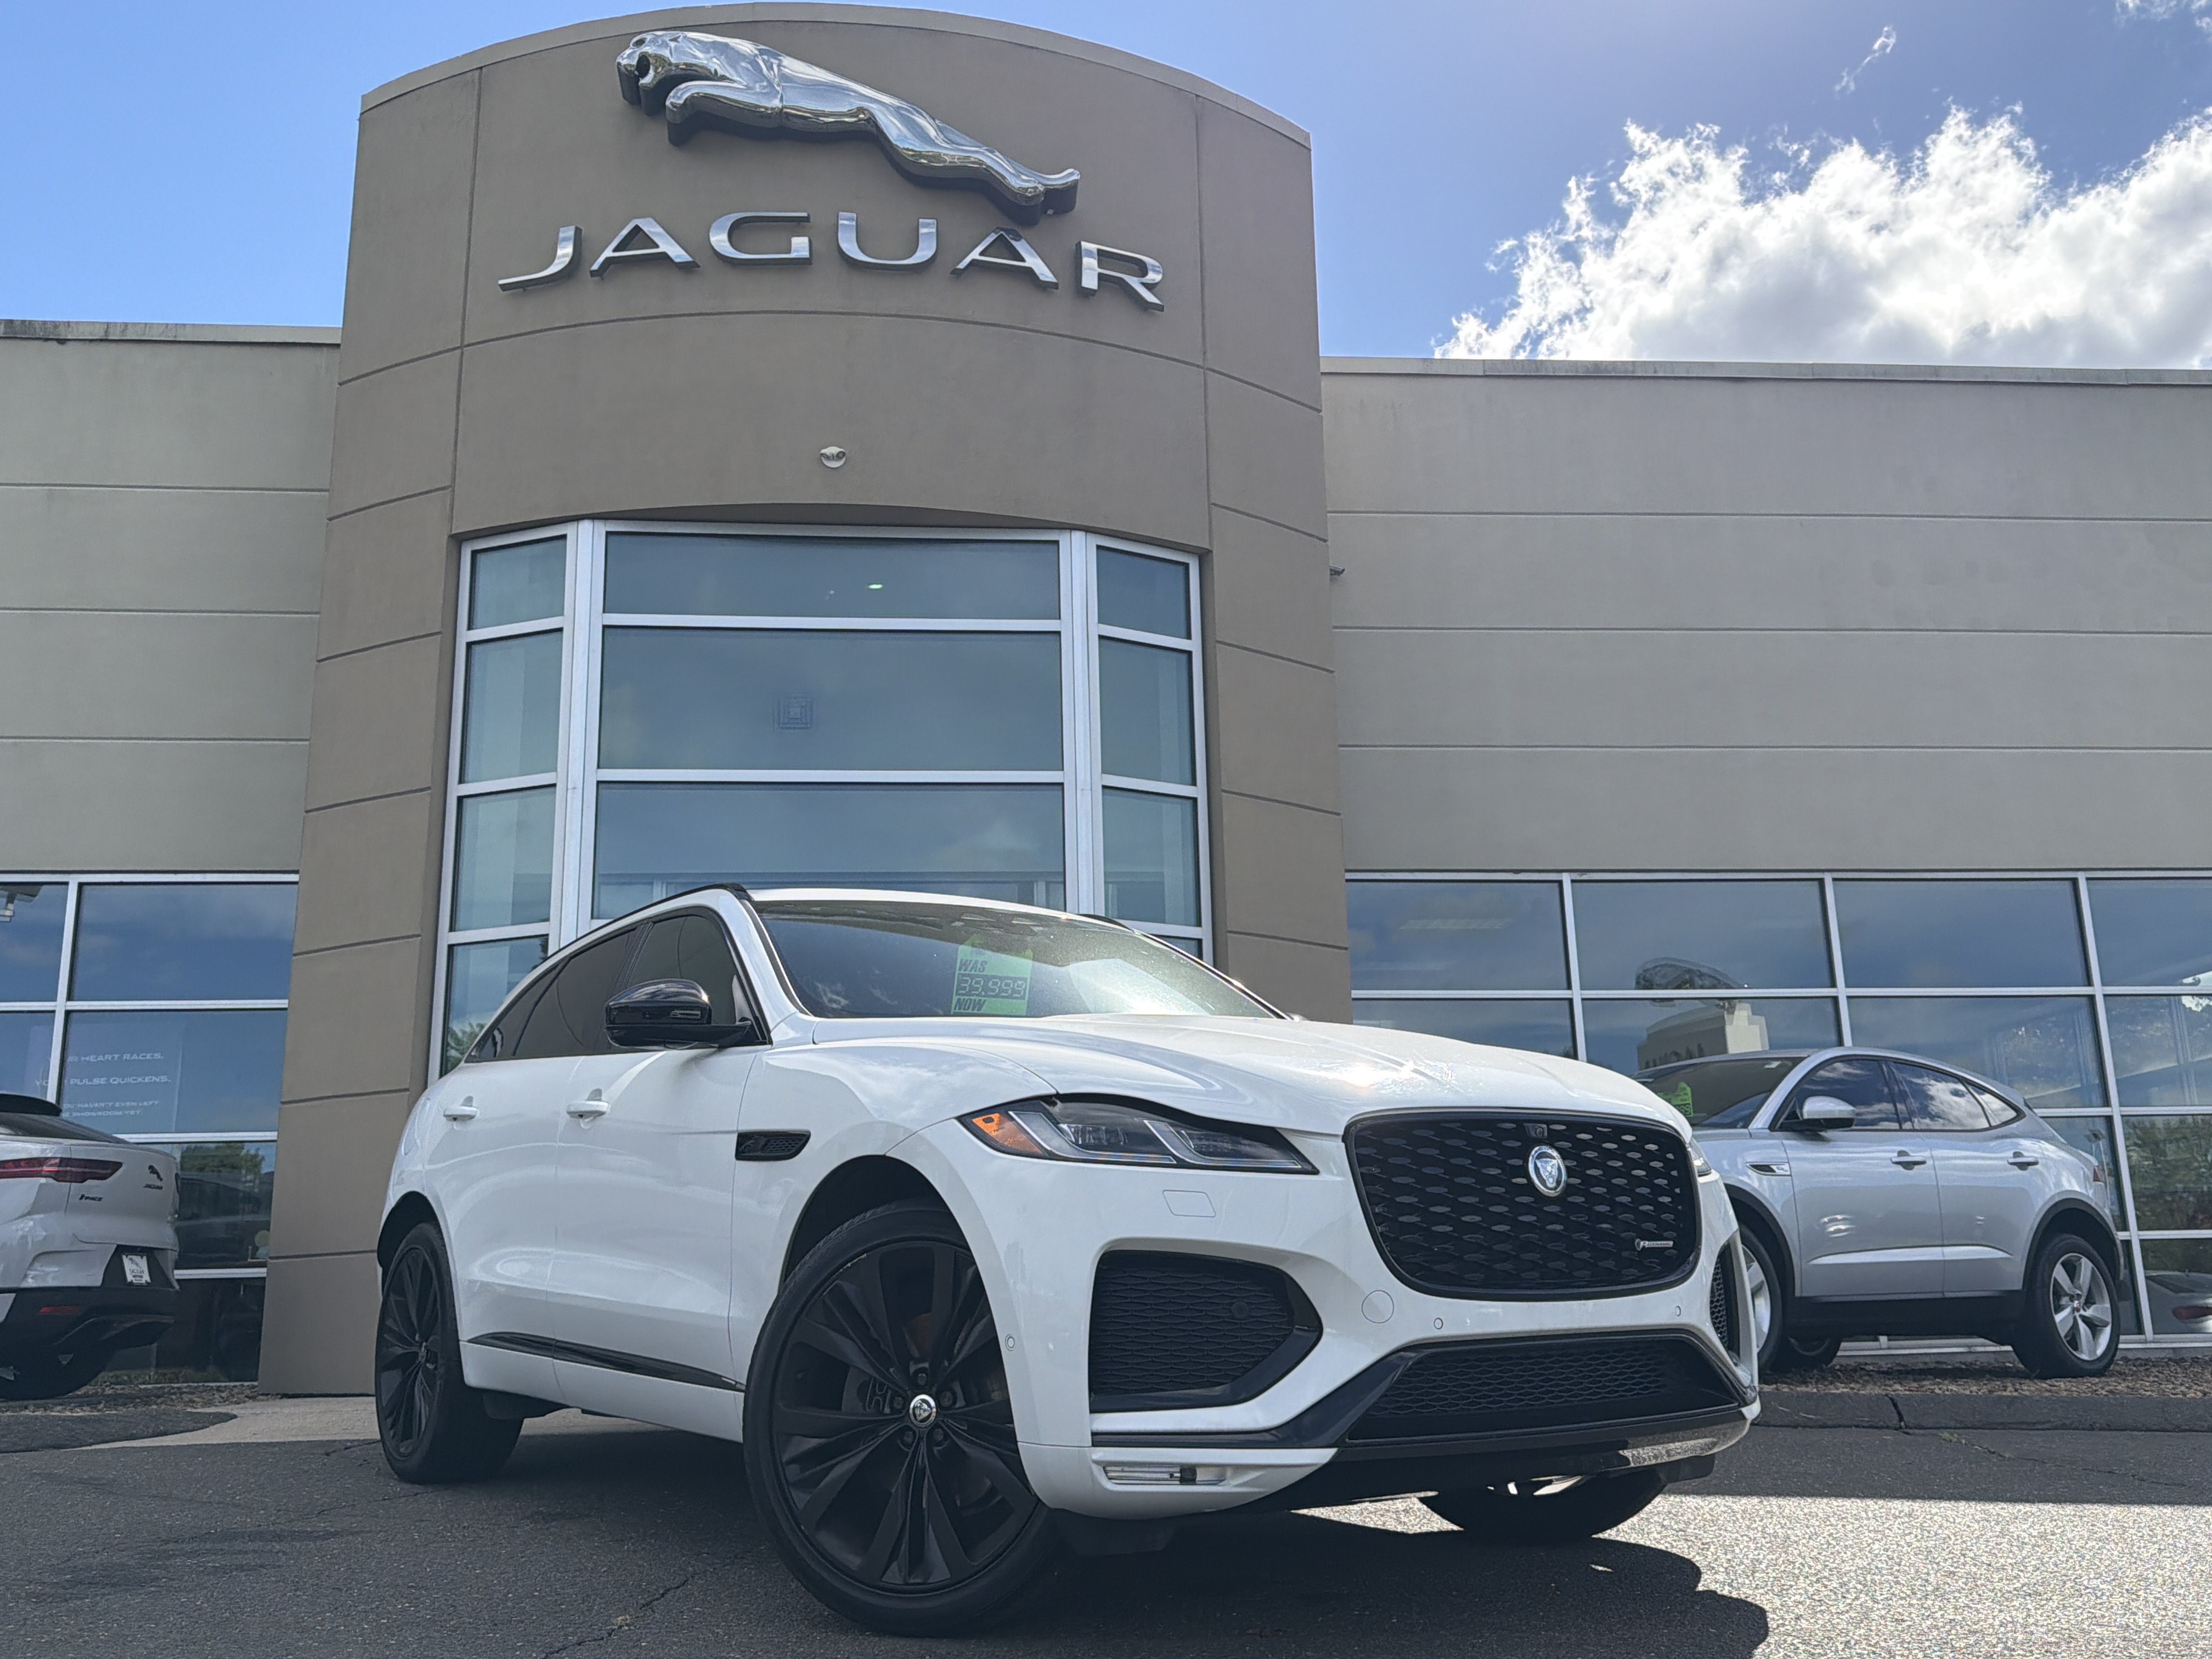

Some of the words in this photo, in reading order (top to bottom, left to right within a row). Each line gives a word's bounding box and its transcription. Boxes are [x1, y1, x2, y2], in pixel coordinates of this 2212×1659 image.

[498, 212, 1164, 312] JAGUAR
[958, 959, 988, 973] WAS
[953, 998, 987, 1012] NOW
[123, 1052, 164, 1060] RACES.
[70, 1077, 107, 1085] PULSE
[110, 1075, 171, 1084] QUICKENS.
